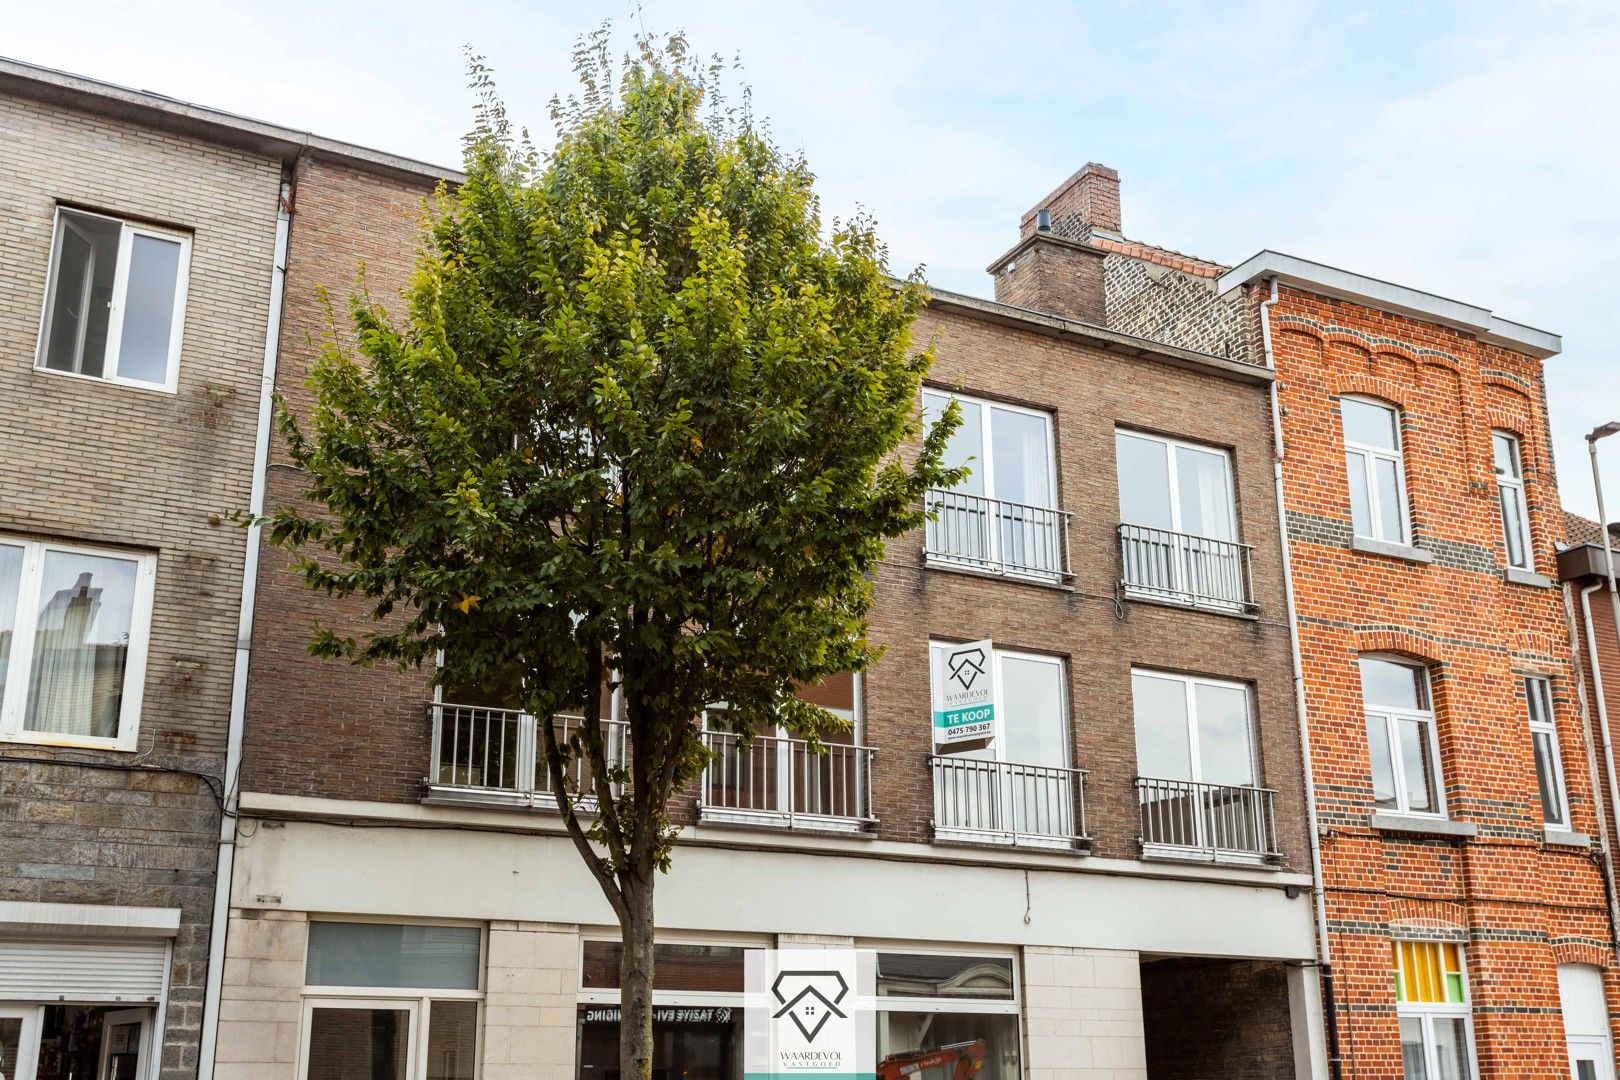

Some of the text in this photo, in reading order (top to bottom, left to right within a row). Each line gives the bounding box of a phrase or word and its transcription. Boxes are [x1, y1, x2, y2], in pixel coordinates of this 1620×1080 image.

[946, 689, 990, 702] WAARDEVOL
[947, 709, 991, 724] TE KOOP
[948, 727, 964, 736] 0475
[965, 725, 978, 733] 790
[979, 723, 991, 731] 367
